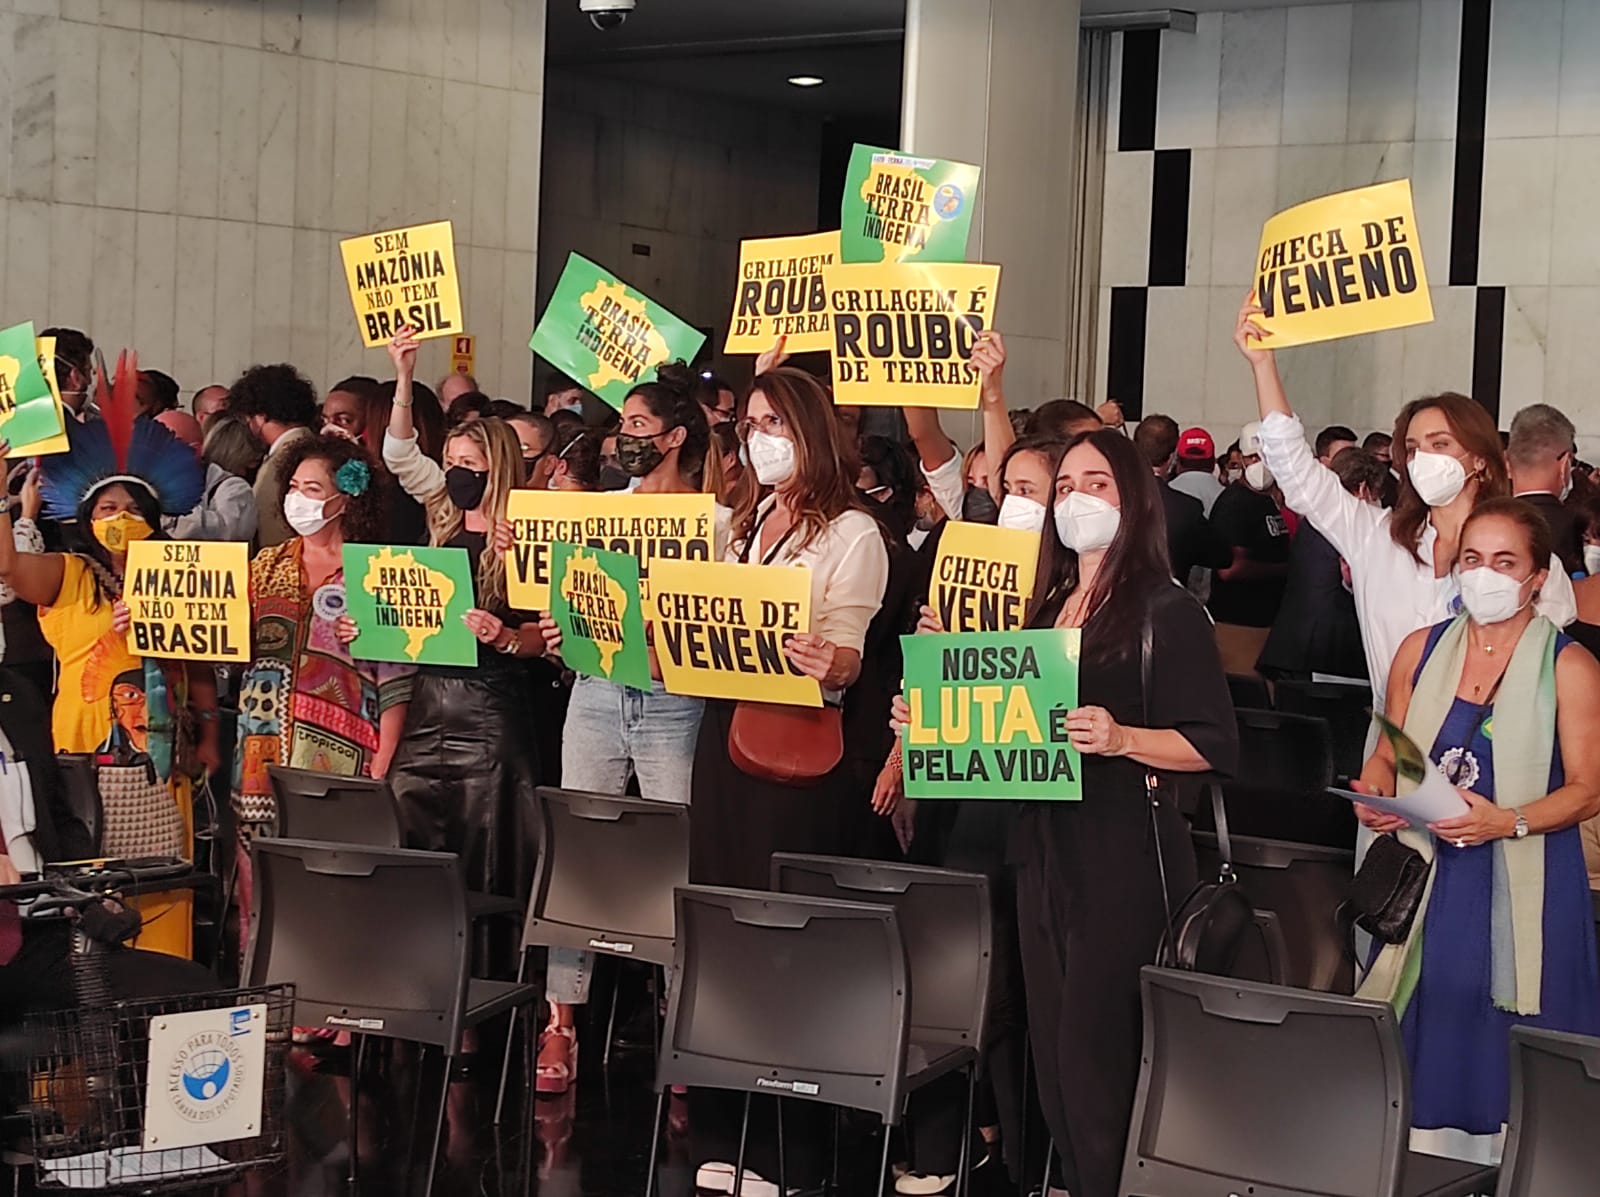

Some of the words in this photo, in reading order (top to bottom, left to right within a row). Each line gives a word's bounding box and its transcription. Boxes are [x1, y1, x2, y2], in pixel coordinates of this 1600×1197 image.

[875, 173, 925, 202] BRASIL
[865, 192, 930, 226] TERRA
[374, 232, 409, 253] SEM
[1260, 228, 1348, 272] CHEGA
[1361, 215, 1407, 250] DE
[356, 250, 445, 291] AMAZÔNIA
[743, 253, 834, 280] GRILAGEM
[1258, 246, 1417, 318] VENENO
[366, 288, 393, 310] NÃO
[401, 281, 438, 303] TEM
[738, 275, 826, 317] ROUB
[831, 289, 957, 313] GRILAGEM
[967, 285, 986, 313] É
[364, 301, 452, 341] BRASIL
[583, 305, 652, 366] TERRA
[599, 295, 651, 343] BRASIL
[734, 318, 762, 336] DE
[772, 313, 830, 336] TERRA
[834, 313, 984, 359] ROUBO
[838, 361, 869, 382] DE
[513, 519, 583, 544] CHEGA
[585, 517, 686, 538] GRILAGEM
[696, 513, 708, 538] É
[163, 544, 201, 563] SEM
[513, 543, 549, 584] VE
[131, 563, 237, 599] AMAZÔNIA
[379, 567, 432, 587] BRASIL
[572, 570, 609, 597] BRASIL
[939, 555, 1019, 592] CHEGA
[139, 598, 175, 619] NÃO
[185, 602, 228, 621] TEM
[372, 586, 443, 607] TERRA
[566, 591, 619, 622] TERRA
[657, 592, 746, 626] CHEGA
[760, 600, 800, 630] DE
[938, 584, 1021, 632] VENE
[132, 620, 239, 655] BRASIL
[943, 646, 1041, 681] NOSSA
[908, 685, 1043, 745] LUTA
[1050, 702, 1069, 743] É
[298, 730, 355, 760] tropicool
[908, 749, 989, 782] PELA
[994, 749, 1075, 782] VIDA
[169, 1050, 188, 1092] ACESSO
[188, 1034, 213, 1052] PARA
[216, 1034, 244, 1063] TODOS
